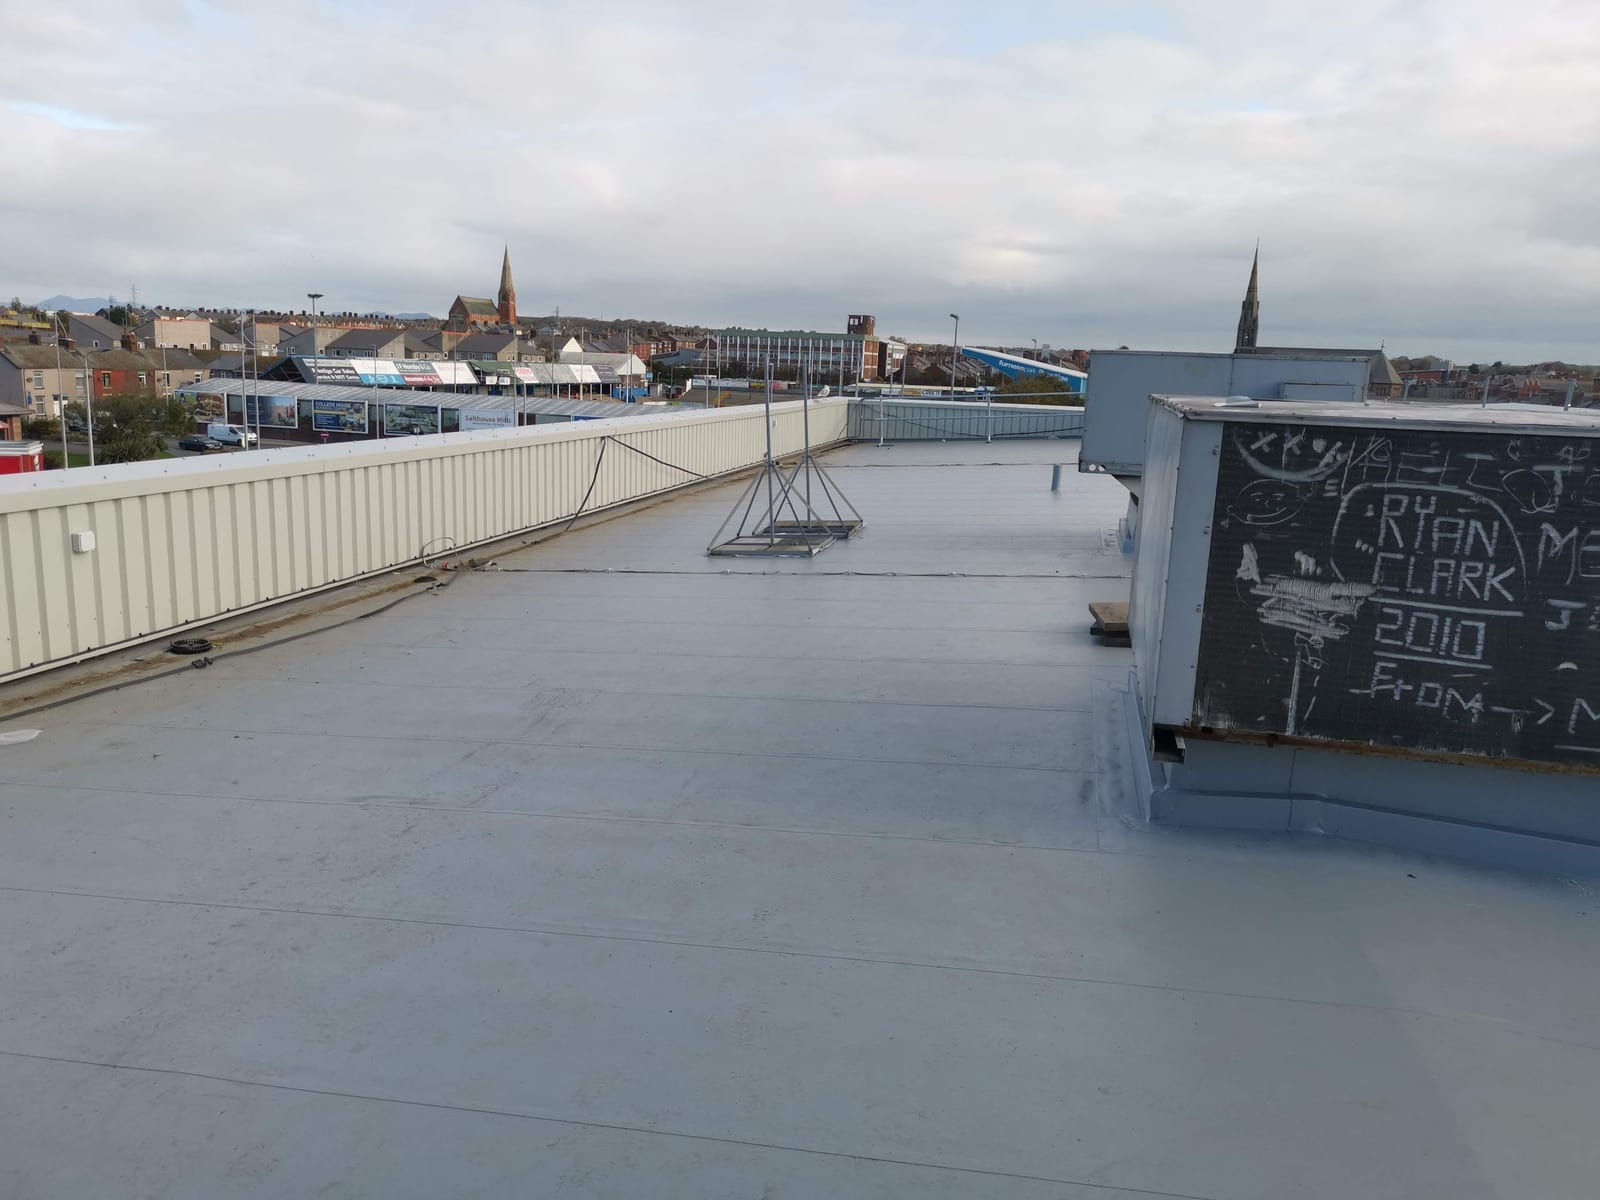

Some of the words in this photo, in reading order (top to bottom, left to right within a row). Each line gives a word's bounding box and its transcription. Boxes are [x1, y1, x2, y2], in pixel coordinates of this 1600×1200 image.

[464, 415, 496, 423] Salthouse
[496, 416, 512, 424] Mills
[1378, 494, 1499, 558] RYAN
[1372, 551, 1516, 602] CLARK
[1374, 607, 1486, 660] 2010
